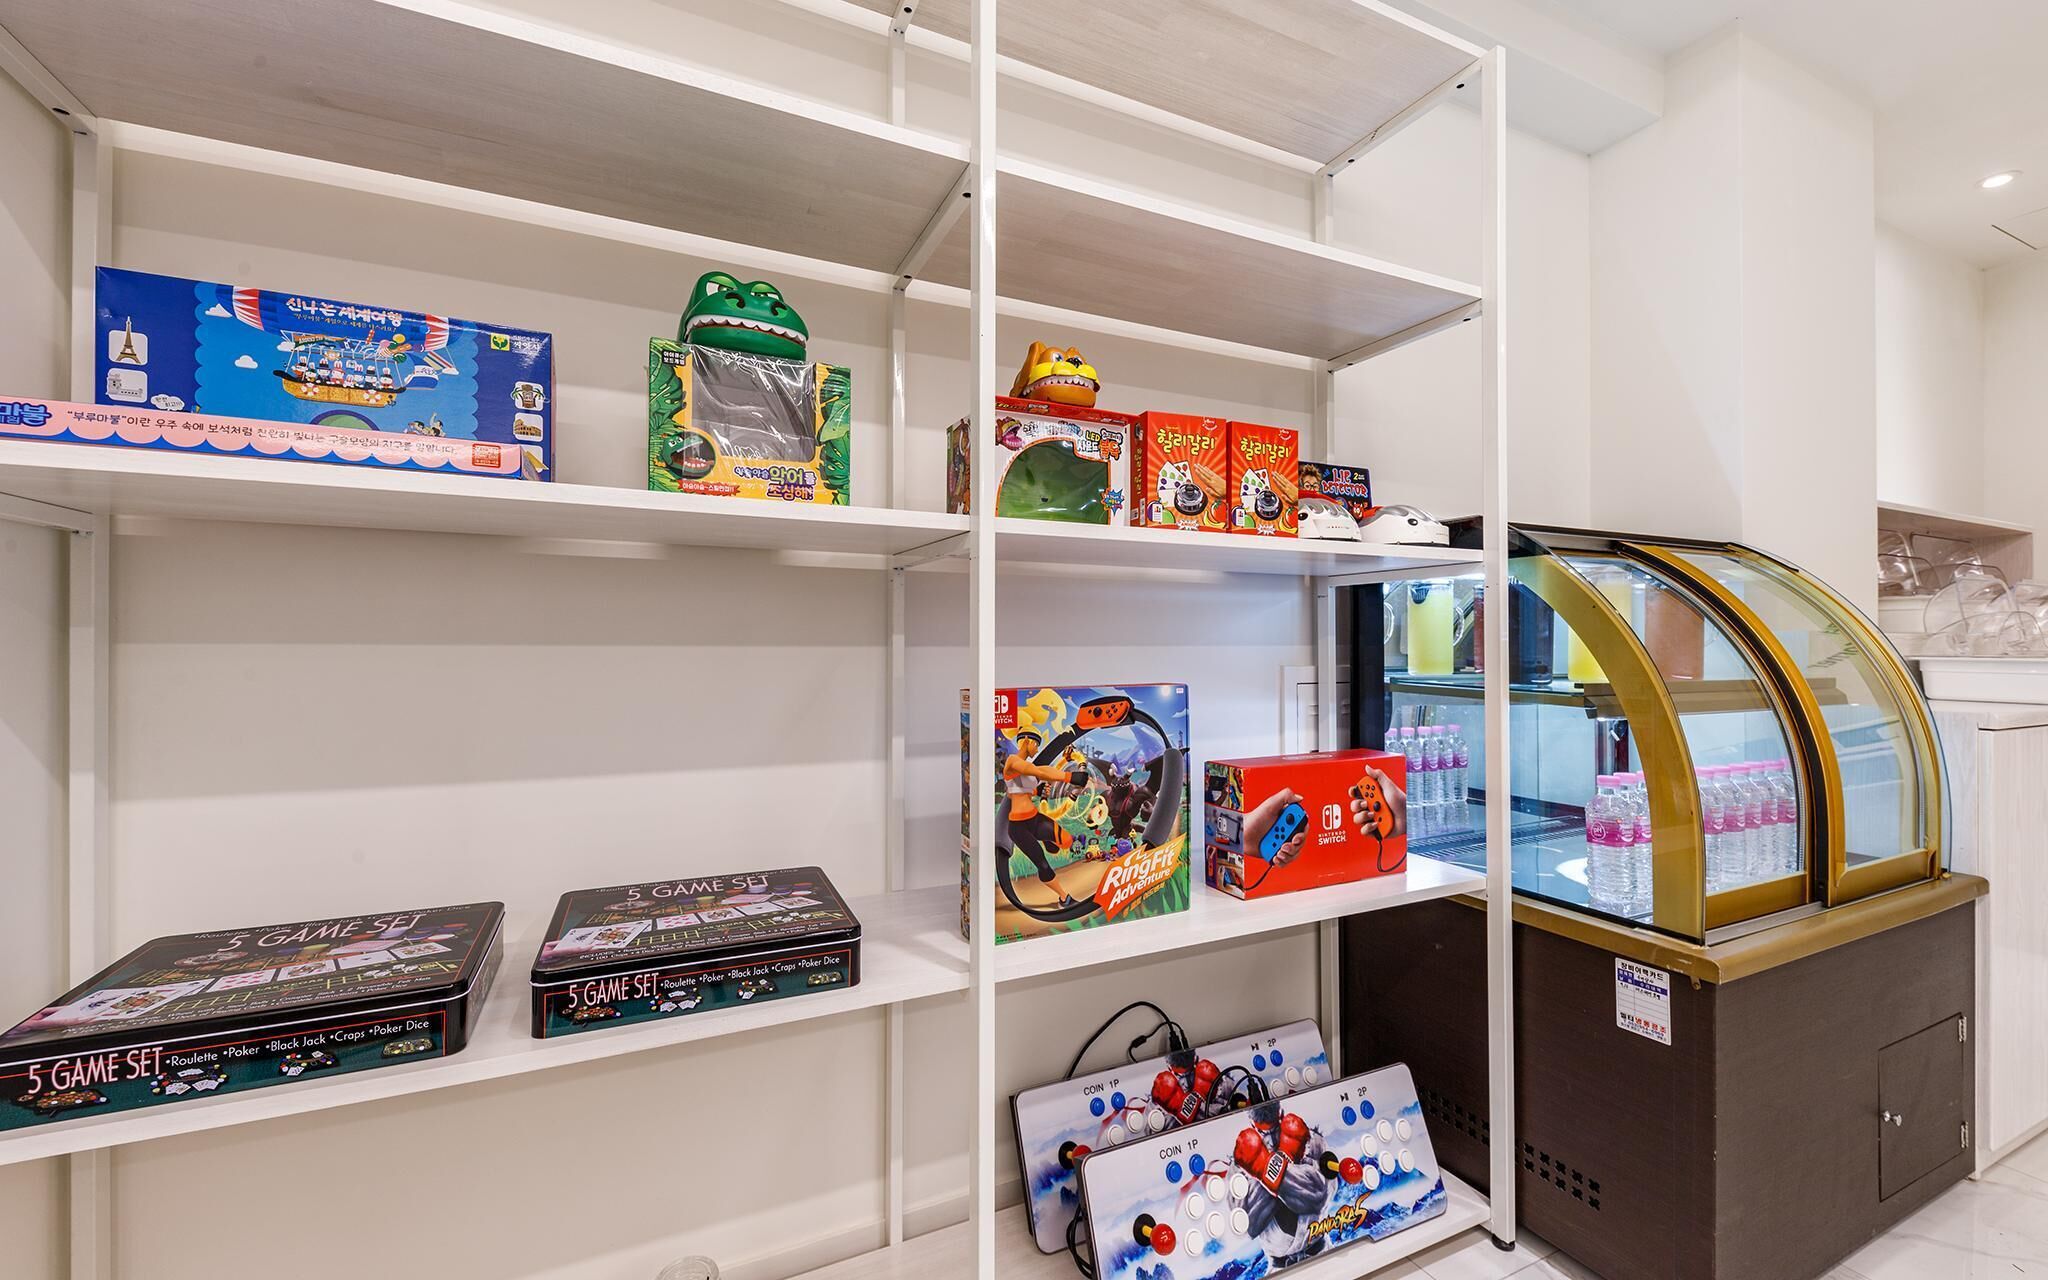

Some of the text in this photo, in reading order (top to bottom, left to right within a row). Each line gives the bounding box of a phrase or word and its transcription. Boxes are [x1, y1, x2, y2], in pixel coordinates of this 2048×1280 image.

[286, 297, 403, 327] 신나는 세계여행
[156, 418, 178, 430] 우주
[182, 421, 204, 431] 속에
[208, 424, 253, 436] 보석처럼
[1086, 430, 1101, 442] LED
[1156, 428, 1215, 456] 할리갈리
[1240, 437, 1289, 464] 할리갈리
[1332, 468, 1352, 482] LIE
[767, 484, 814, 500] 조심해!
[1321, 480, 1368, 498] DETECTOR
[1318, 830, 1346, 838] NINTENDO
[1318, 836, 1347, 846] SWITCH
[627, 875, 769, 901] 5 GAME SET
[1108, 868, 1170, 912] Adventure
[217, 913, 428, 952] 5 GAME SET
[568, 956, 840, 1008] 5 GAME SET Roulette Poker Black Jack Craps Poker Dice
[1267, 1038, 1277, 1048] 2P
[28, 1020, 430, 1094] 5 GAME SET Roulette Poker Black Jack Craps Poker Dice
[1084, 1078, 1120, 1096] COIN 1P
[1357, 1086, 1368, 1097] 2P
[1160, 1139, 1198, 1160] COIN 1P
